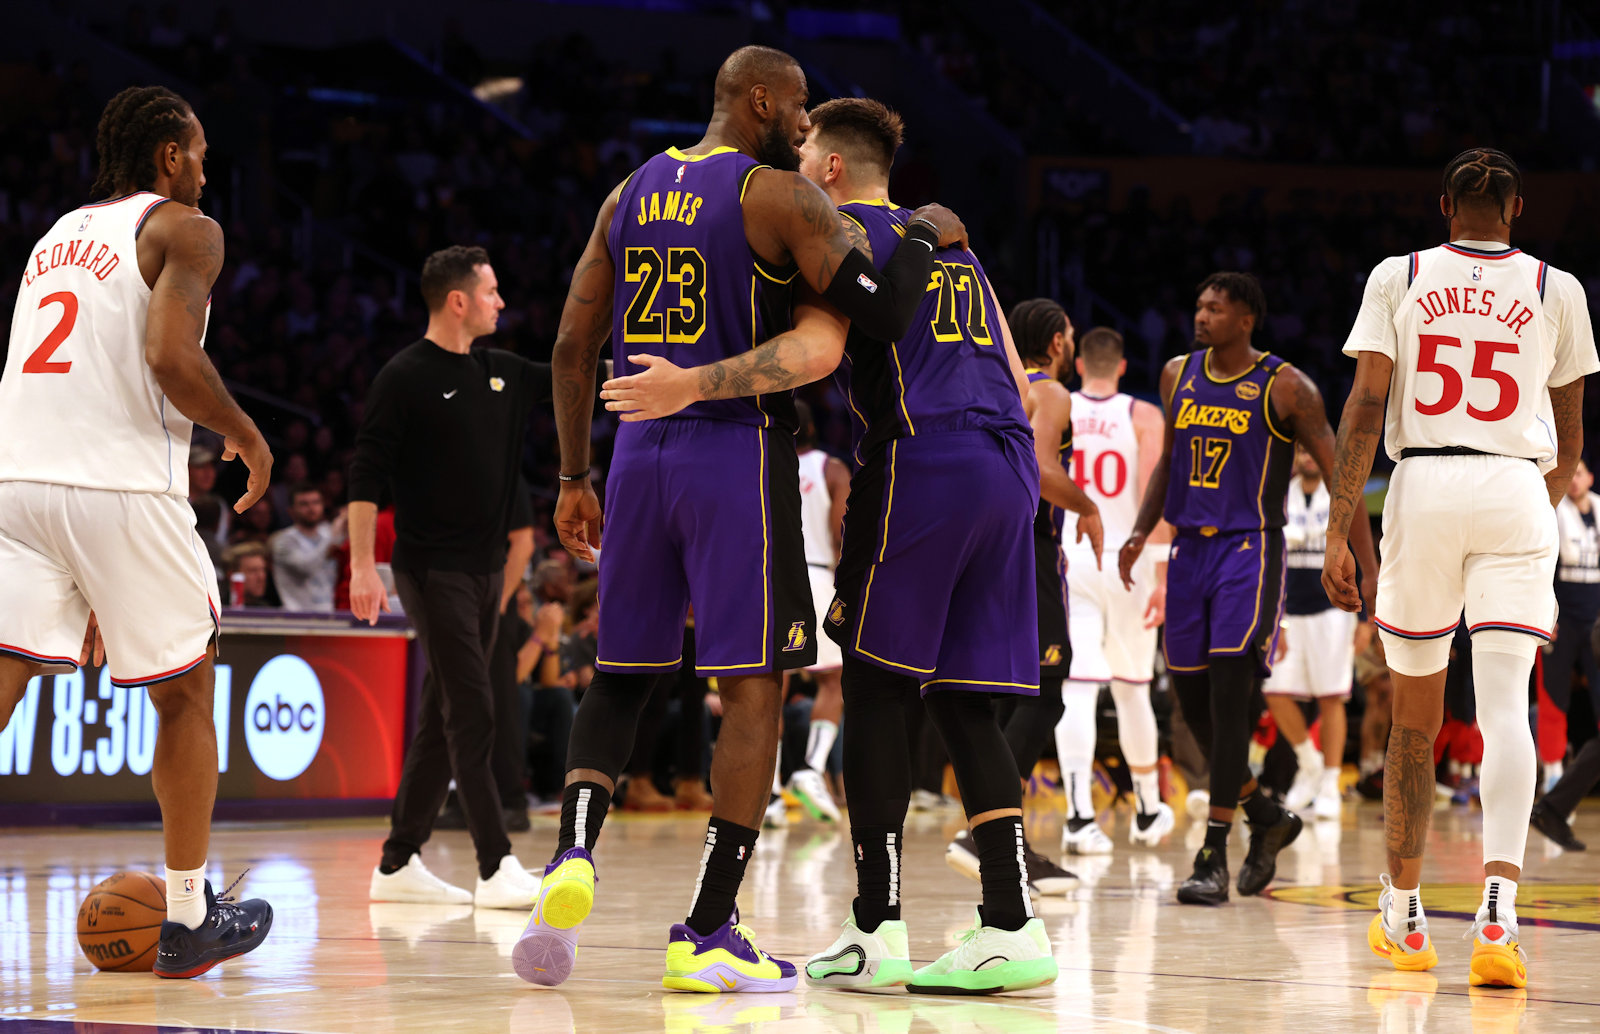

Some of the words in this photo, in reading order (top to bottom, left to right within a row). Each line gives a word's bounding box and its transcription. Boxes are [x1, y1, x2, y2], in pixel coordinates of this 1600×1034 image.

[637, 190, 704, 226] JAMES
[24, 239, 120, 287] LEONARD
[624, 247, 706, 344] 23
[926, 260, 994, 346] 77
[1417, 287, 1496, 325] JONES
[1496, 299, 1534, 338] JR.
[22, 291, 79, 373] 2
[1415, 334, 1520, 422] 55
[1174, 398, 1252, 435] LAKERS
[1072, 450, 1127, 498] 40
[1189, 436, 1232, 489] 17
[51, 664, 159, 777] 8:30
[253, 693, 316, 733] abc
